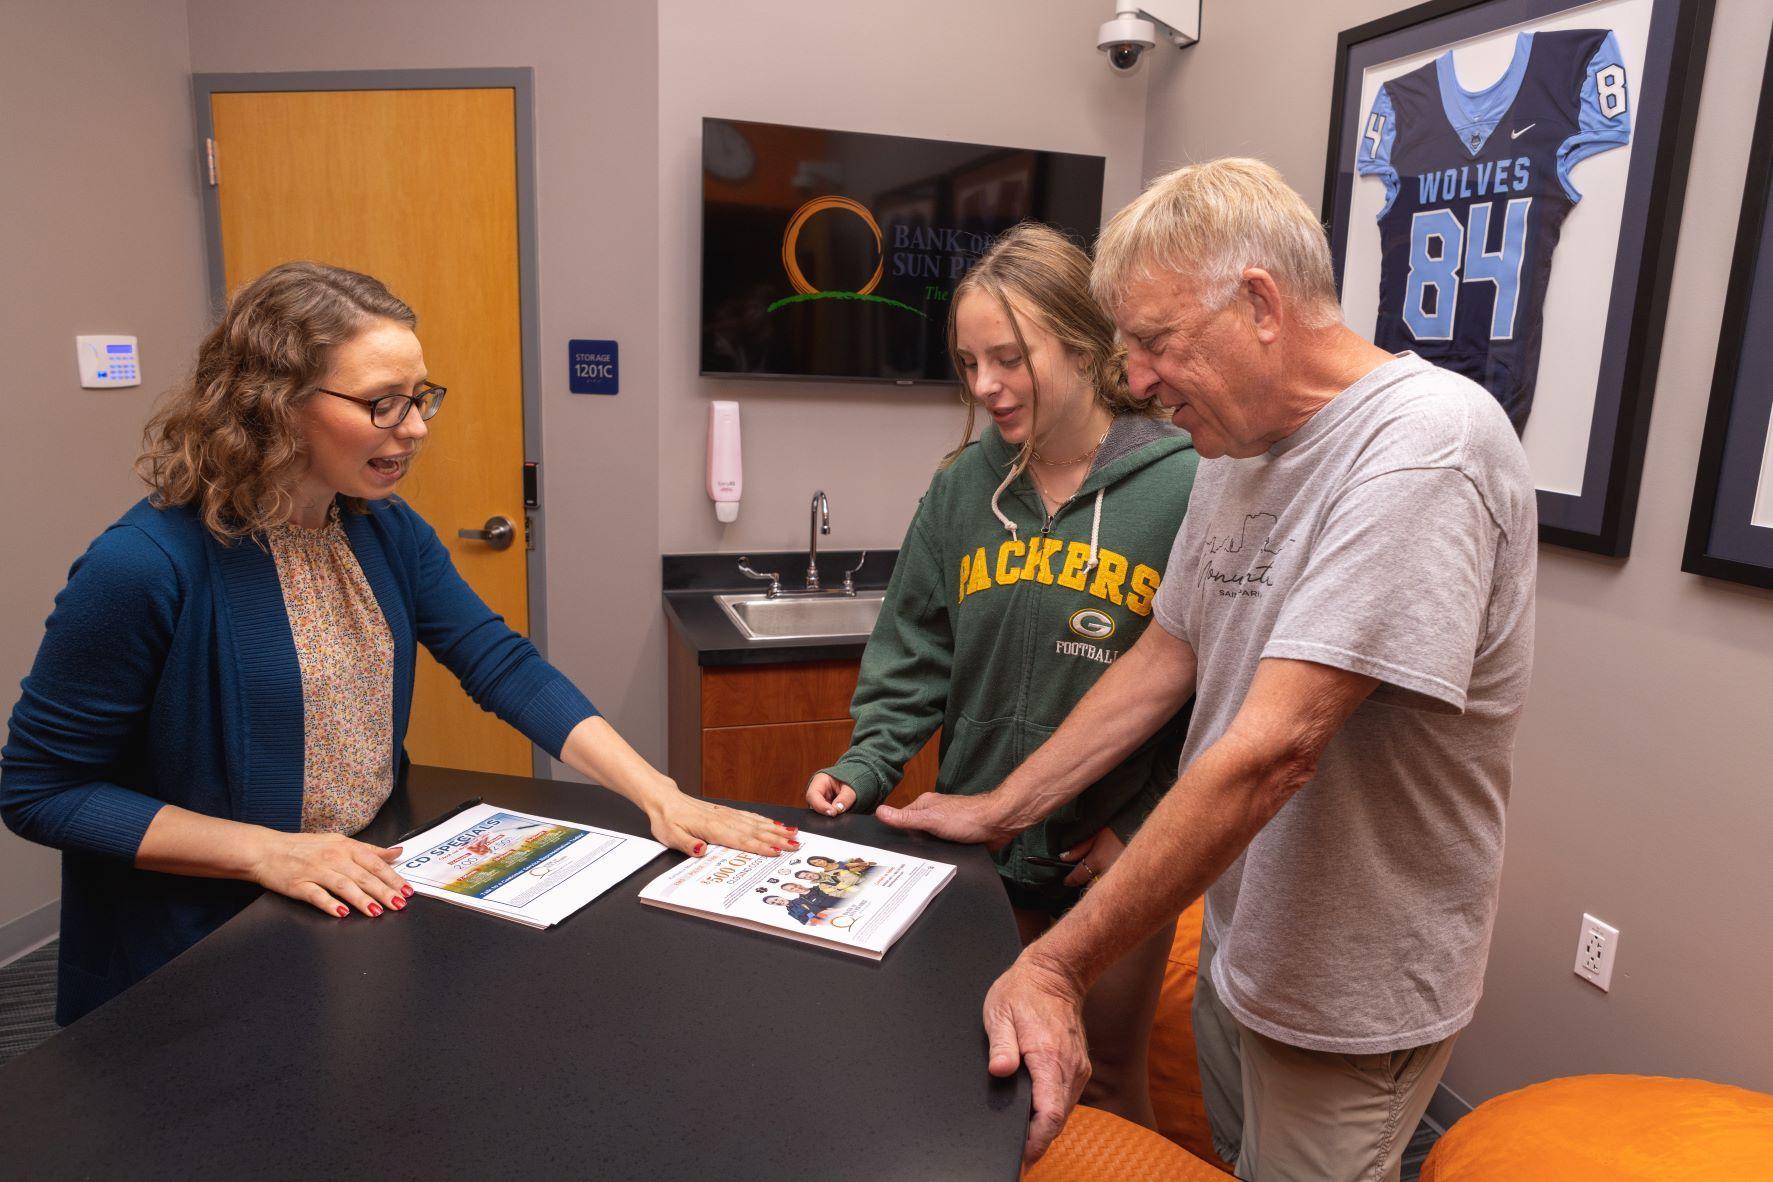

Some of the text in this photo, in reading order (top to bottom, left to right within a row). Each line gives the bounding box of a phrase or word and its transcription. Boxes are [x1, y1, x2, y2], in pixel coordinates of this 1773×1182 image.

[1595, 63, 1628, 119] 8
[1365, 111, 1386, 160] 4
[1418, 156, 1531, 206] WOLVES
[895, 224, 961, 251] BANK
[893, 252, 941, 278] SUN
[1402, 196, 1533, 341] 84
[926, 286, 948, 300] The
[575, 353, 611, 362] STORAGE
[575, 364, 613, 378] 1201C
[958, 537, 1161, 617] PACKERS
[1072, 611, 1112, 638] G
[405, 856, 431, 869] CD
[430, 820, 501, 856] SPECIALS
